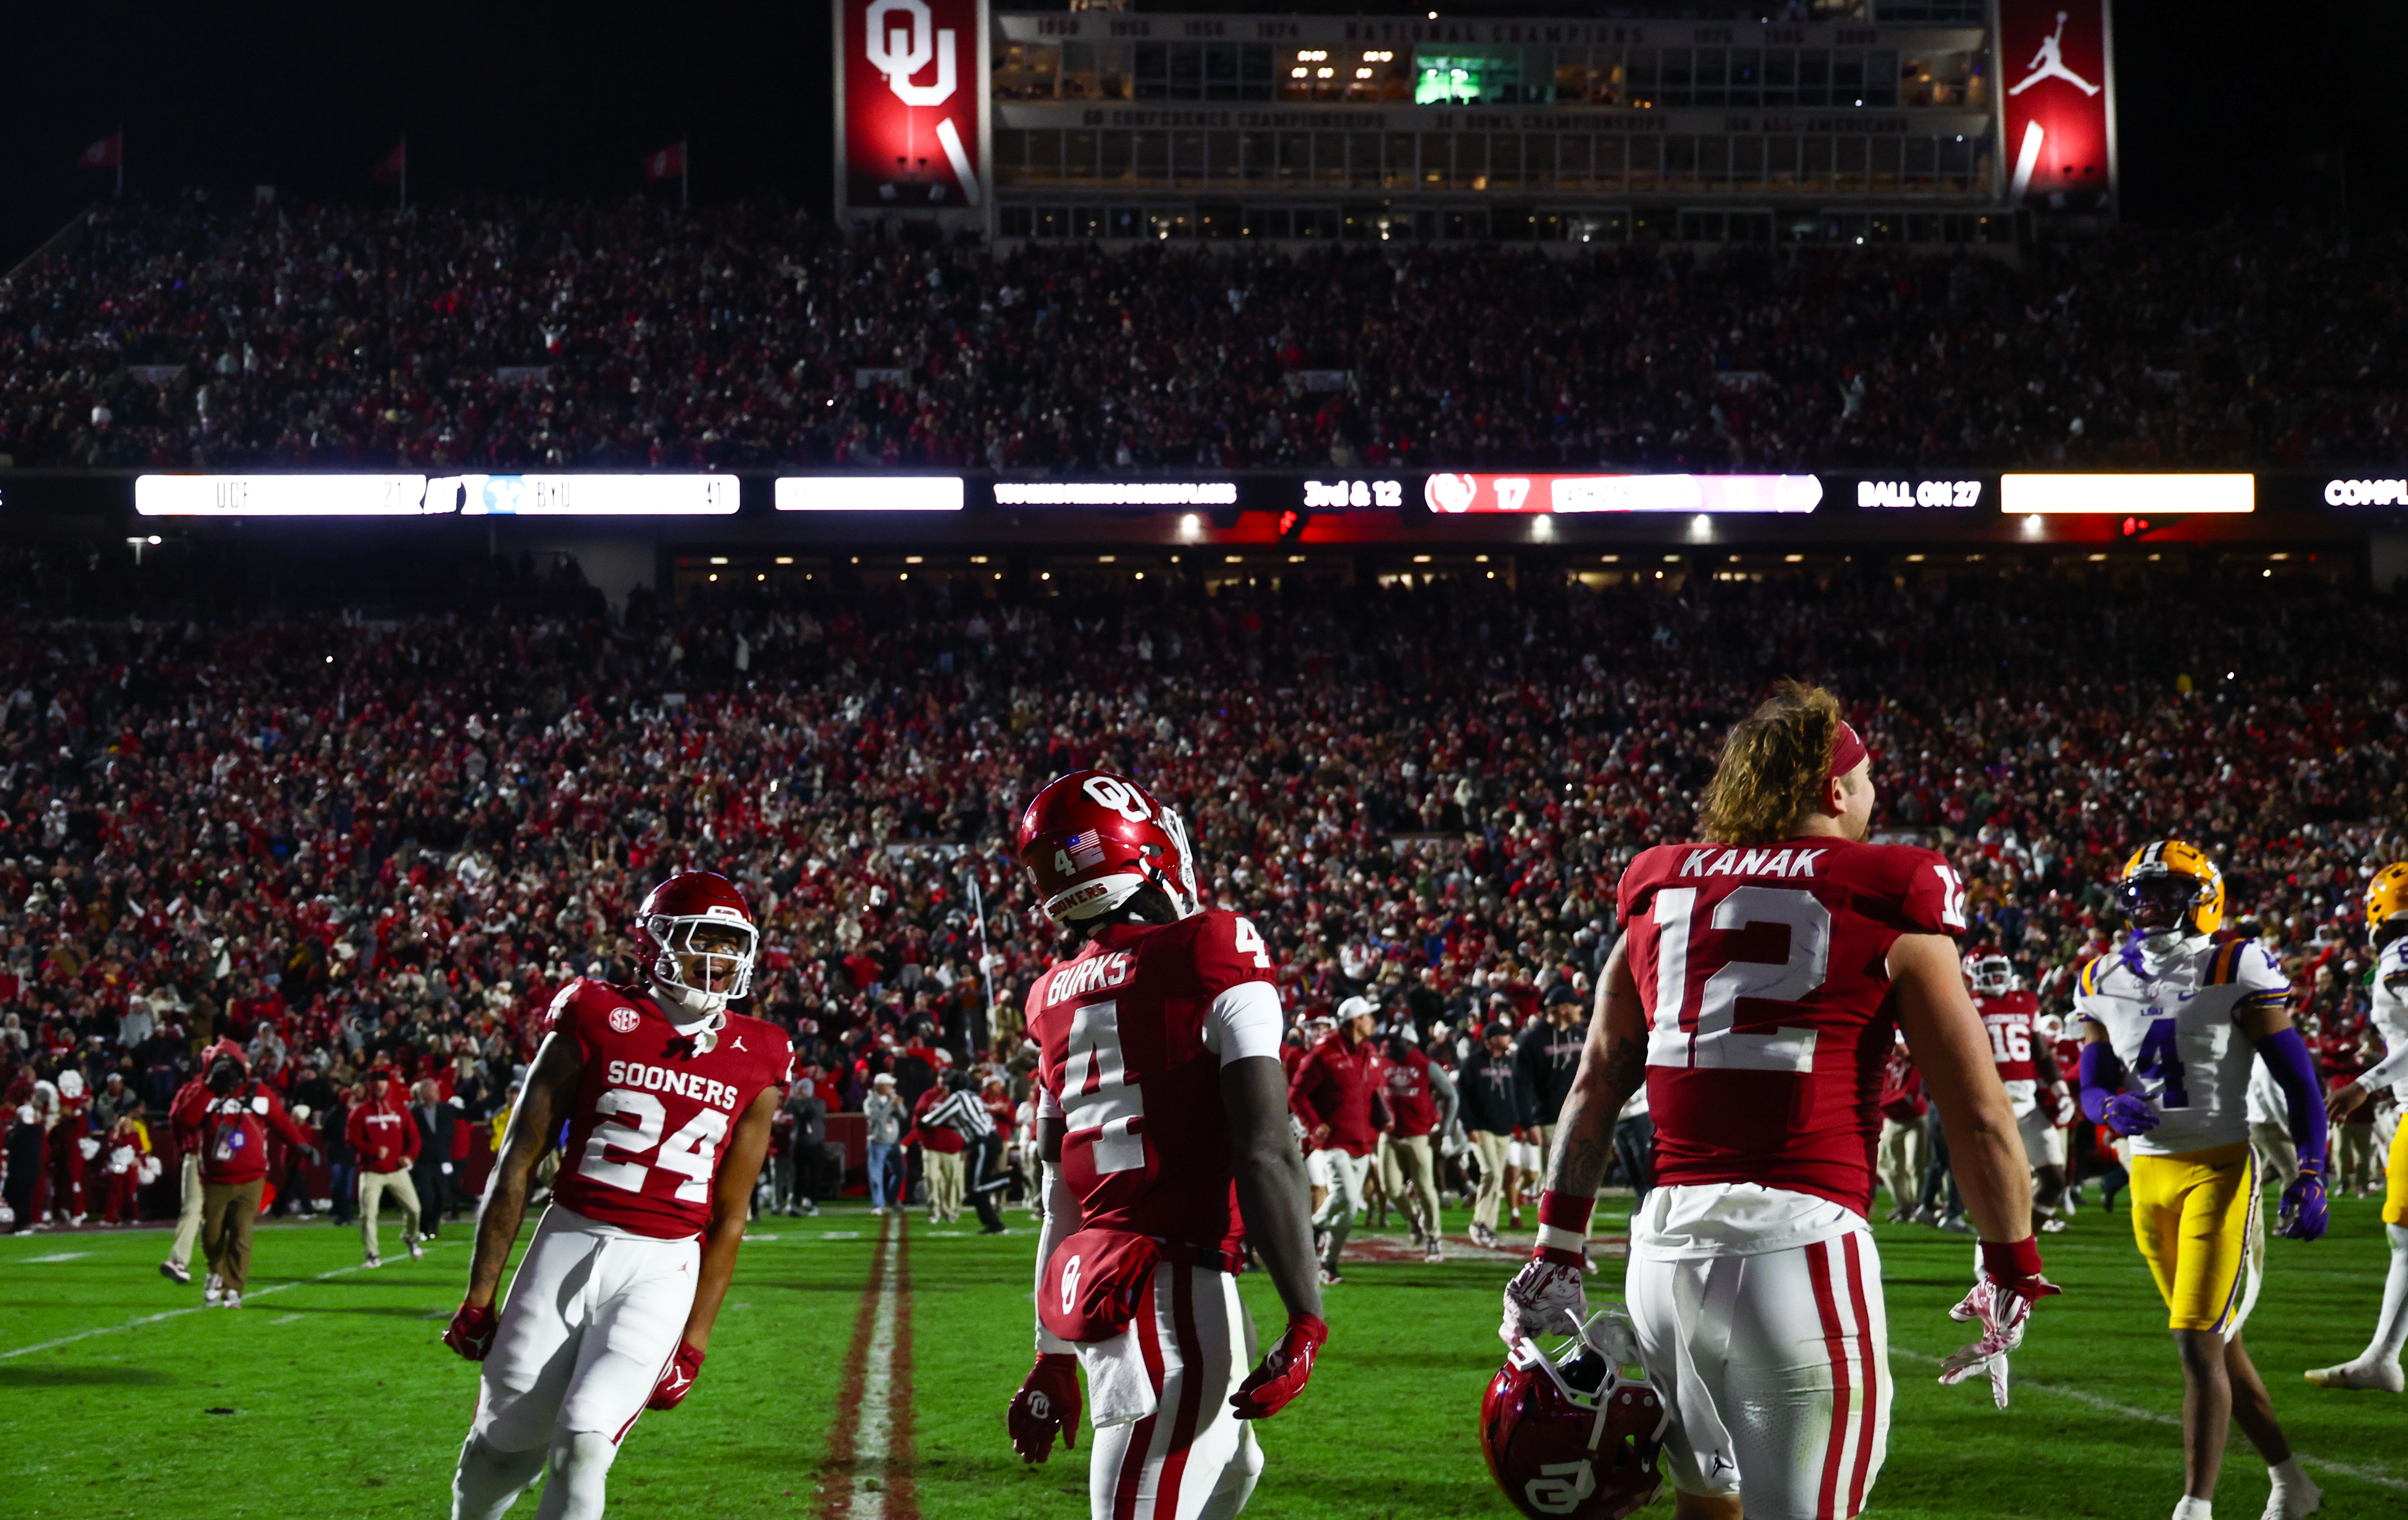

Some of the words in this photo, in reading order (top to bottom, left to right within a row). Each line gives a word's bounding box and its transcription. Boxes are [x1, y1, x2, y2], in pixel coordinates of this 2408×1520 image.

[1345, 23, 1474, 41] NATIONAL
[1492, 25, 1643, 43] CHAMPIONS
[865, 0, 957, 106] OU
[1113, 111, 1229, 127] CONFERENCE
[1238, 112, 1385, 128] CHAMPIONSHIPS
[1467, 114, 1515, 129] BOWL
[1522, 115, 1667, 130] CHAMPIONSHIPS
[1763, 117, 1908, 133] ALL-AMERICANS
[537, 482, 570, 507] BYU
[1304, 481, 1348, 507] 3rd
[1350, 481, 1370, 507] &
[1372, 481, 1401, 506] 12
[1493, 478, 1530, 509] 17
[1858, 481, 1916, 507] BALL
[1916, 481, 1952, 507] ON
[1953, 481, 1981, 507] 27
[1082, 775, 1152, 823] OU
[1054, 849, 1077, 877] 4
[1679, 848, 1830, 878] KANAK
[1235, 916, 1271, 968] 4
[1047, 948, 1133, 1006] BURKS
[1645, 885, 1832, 1073] 12
[612, 1011, 638, 1031] SEC
[1987, 1023, 2031, 1062] 16
[2137, 1019, 2188, 1109] 4
[607, 1060, 738, 1110] SOONERS
[1060, 999, 1145, 1175] 4
[577, 1088, 730, 1204] 24
